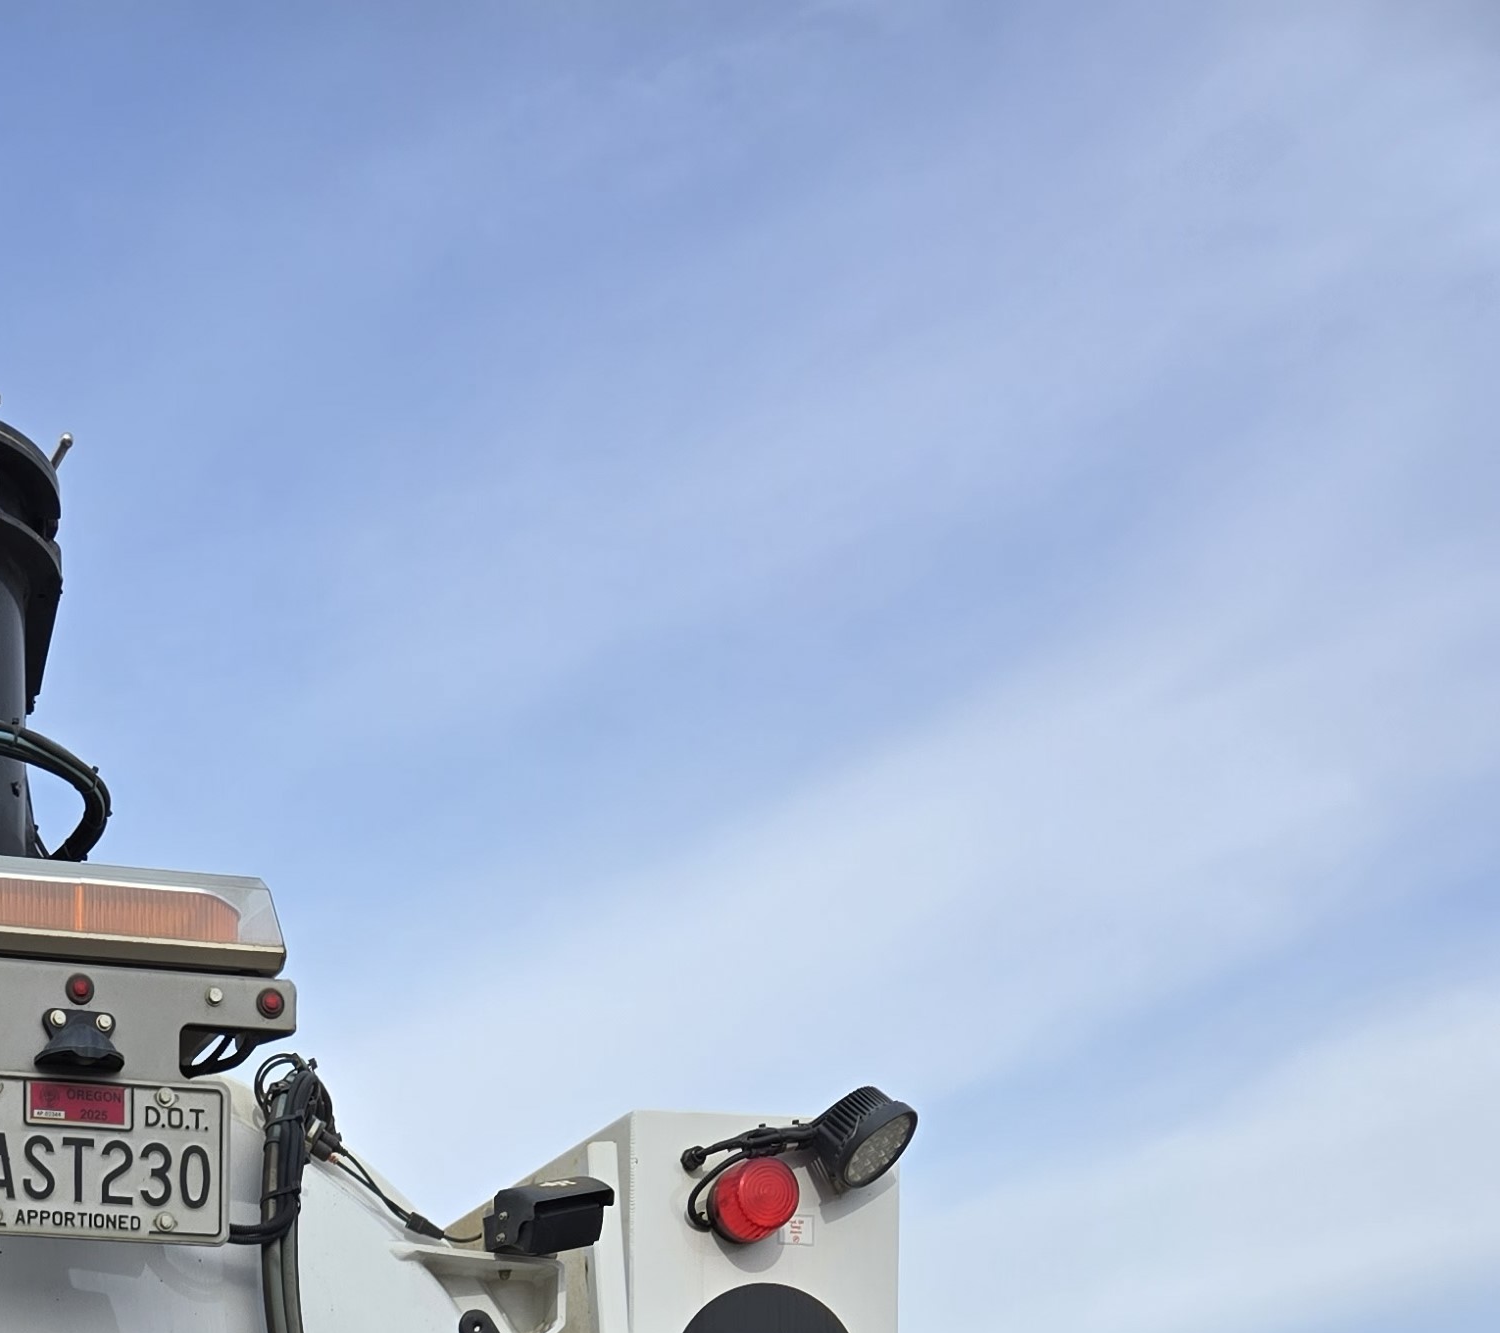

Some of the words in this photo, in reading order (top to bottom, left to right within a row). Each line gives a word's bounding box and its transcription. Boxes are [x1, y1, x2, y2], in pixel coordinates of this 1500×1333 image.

[66, 1088, 122, 1104] OREGON
[80, 1109, 108, 1120] 2025
[145, 1106, 209, 1132] D.O.T.
[15, 1209, 141, 1231] APPORTIONED
